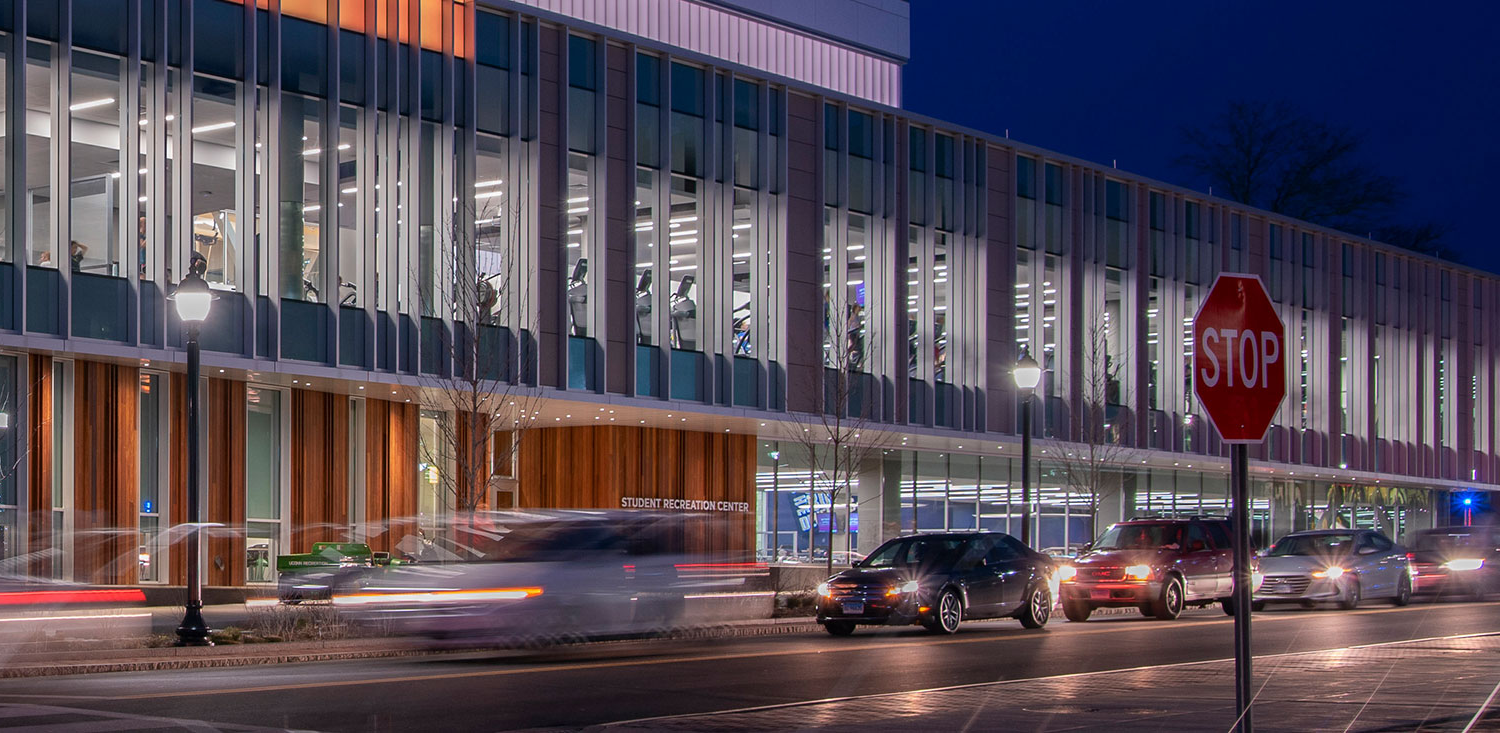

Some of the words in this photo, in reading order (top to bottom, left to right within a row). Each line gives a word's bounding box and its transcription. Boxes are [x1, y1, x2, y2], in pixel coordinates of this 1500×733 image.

[1201, 327, 1280, 389] STOP
[621, 497, 661, 508] STUDENT
[663, 499, 716, 511] RECREATION
[717, 501, 749, 512] CENTER
